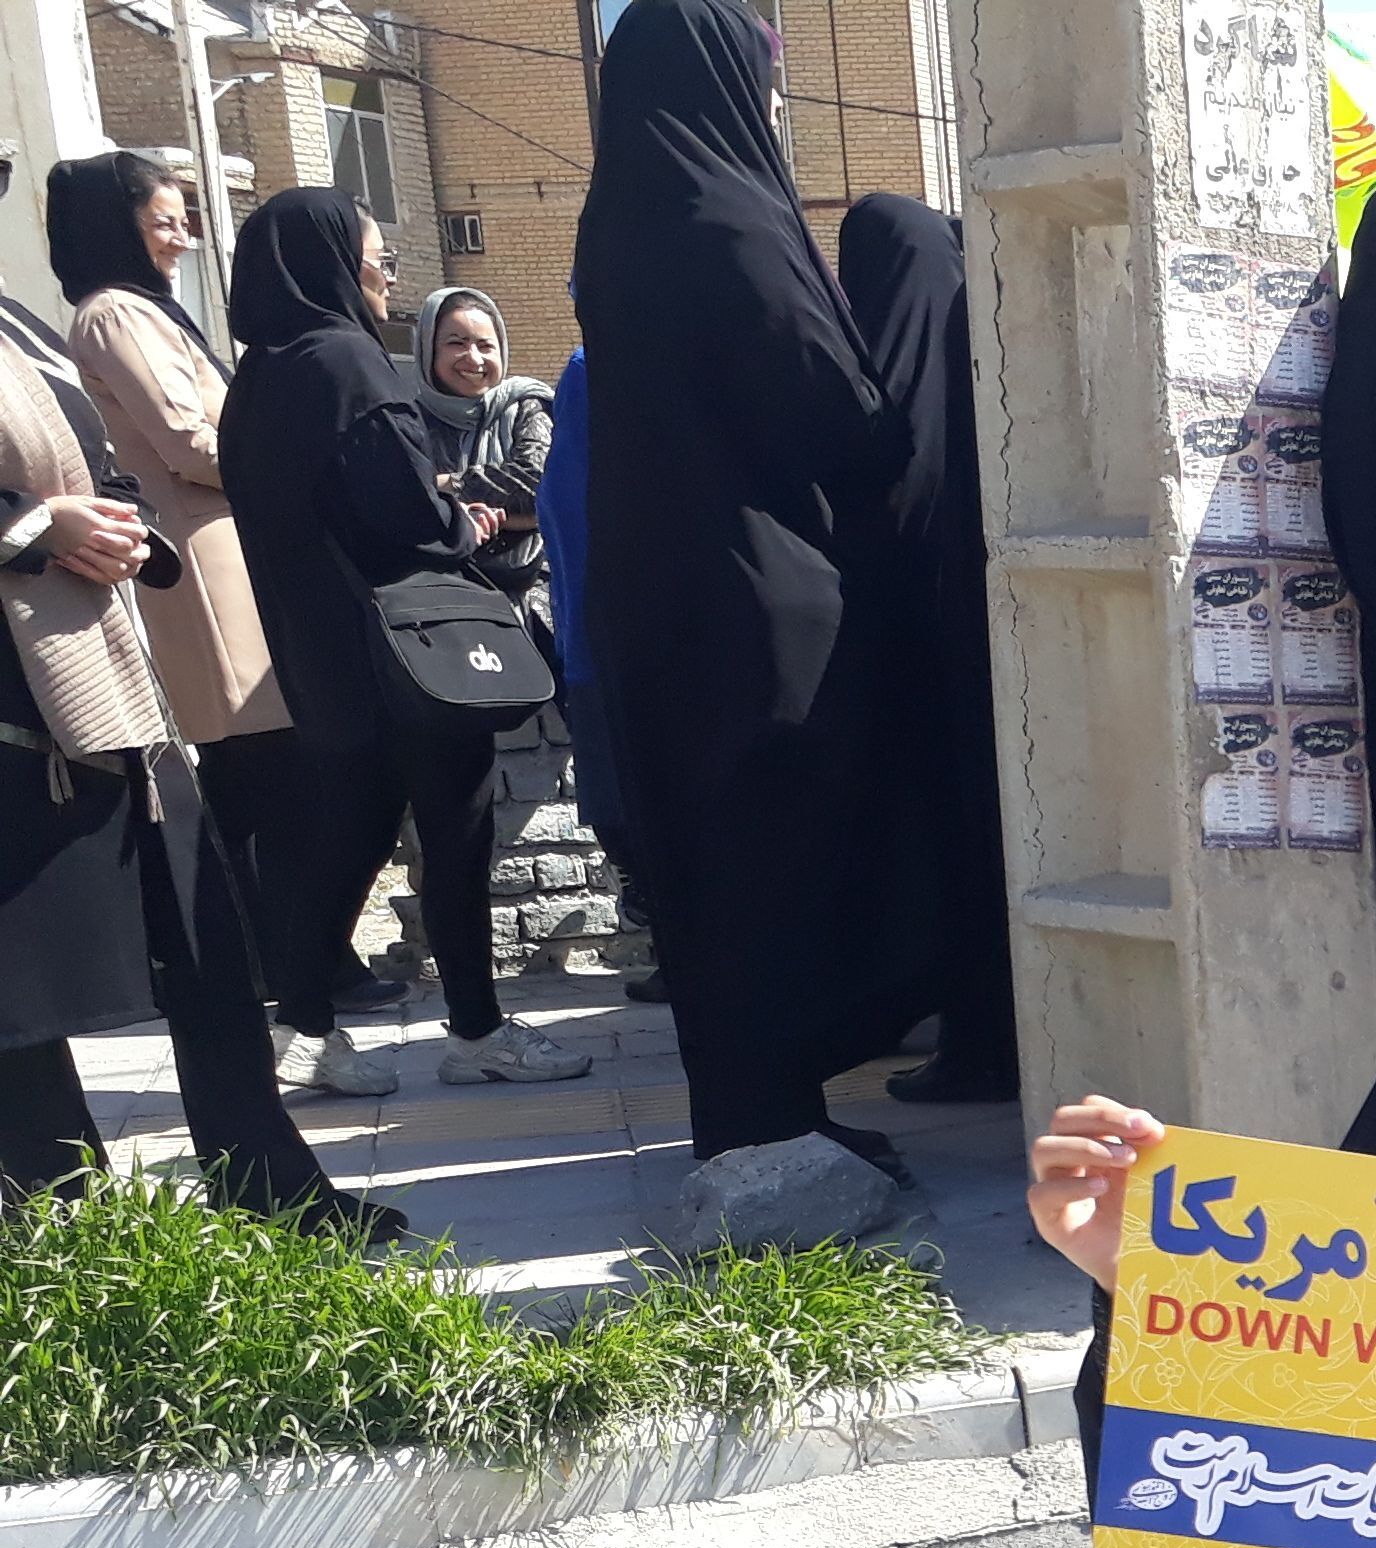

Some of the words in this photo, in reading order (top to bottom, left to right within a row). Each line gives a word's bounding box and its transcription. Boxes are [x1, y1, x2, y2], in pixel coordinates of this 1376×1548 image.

[1296, 430, 1320, 441] ستوران
[1146, 1294, 1332, 1358] DOWN
[1206, 1463, 1332, 1524] اسلام
